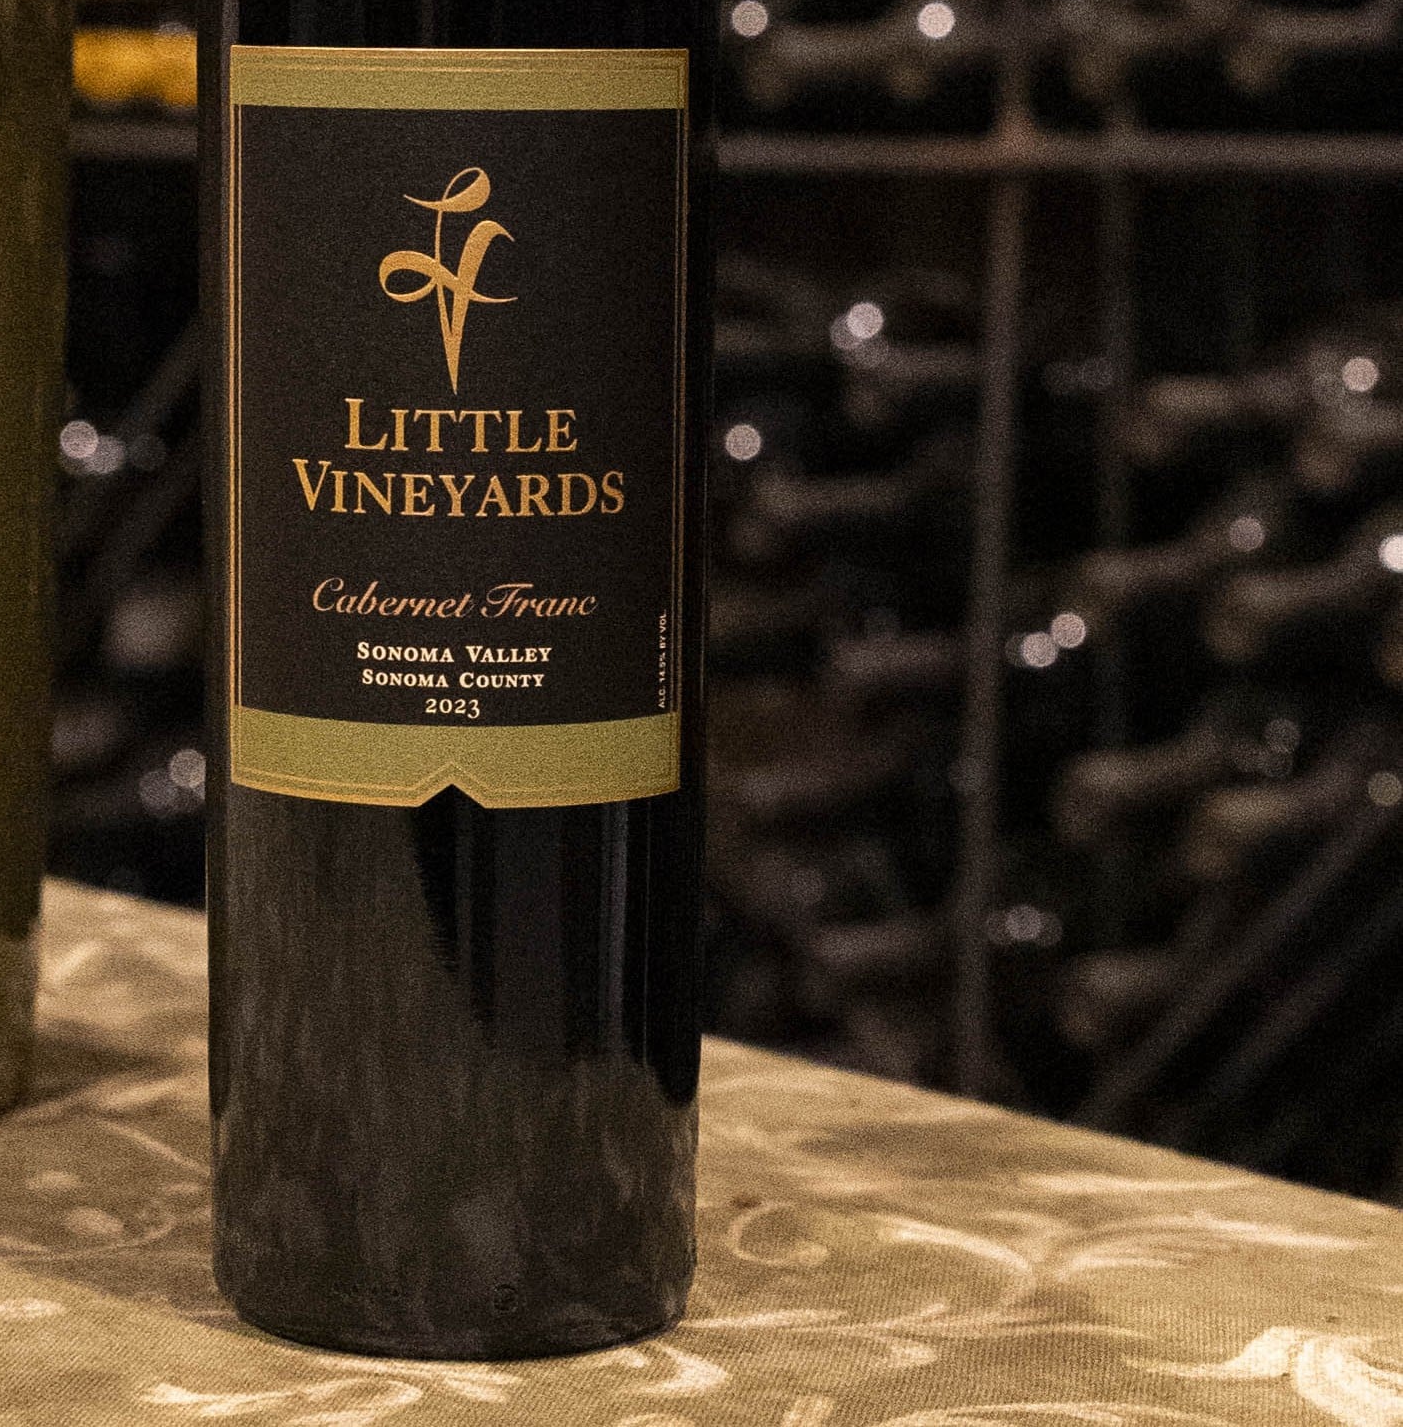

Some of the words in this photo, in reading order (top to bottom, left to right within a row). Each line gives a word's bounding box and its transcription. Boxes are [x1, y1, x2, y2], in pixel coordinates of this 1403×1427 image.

[344, 397, 578, 453] LITTLE
[292, 458, 625, 517] VINEYARDS
[311, 577, 474, 619] Cabernet
[481, 582, 598, 619] Franc
[356, 640, 455, 664] SONOMA
[465, 645, 553, 664] VALLEY
[659, 635, 667, 649] BY
[361, 668, 450, 689] SONOMA
[458, 671, 545, 690] COUNTY
[424, 697, 481, 720] 2023
